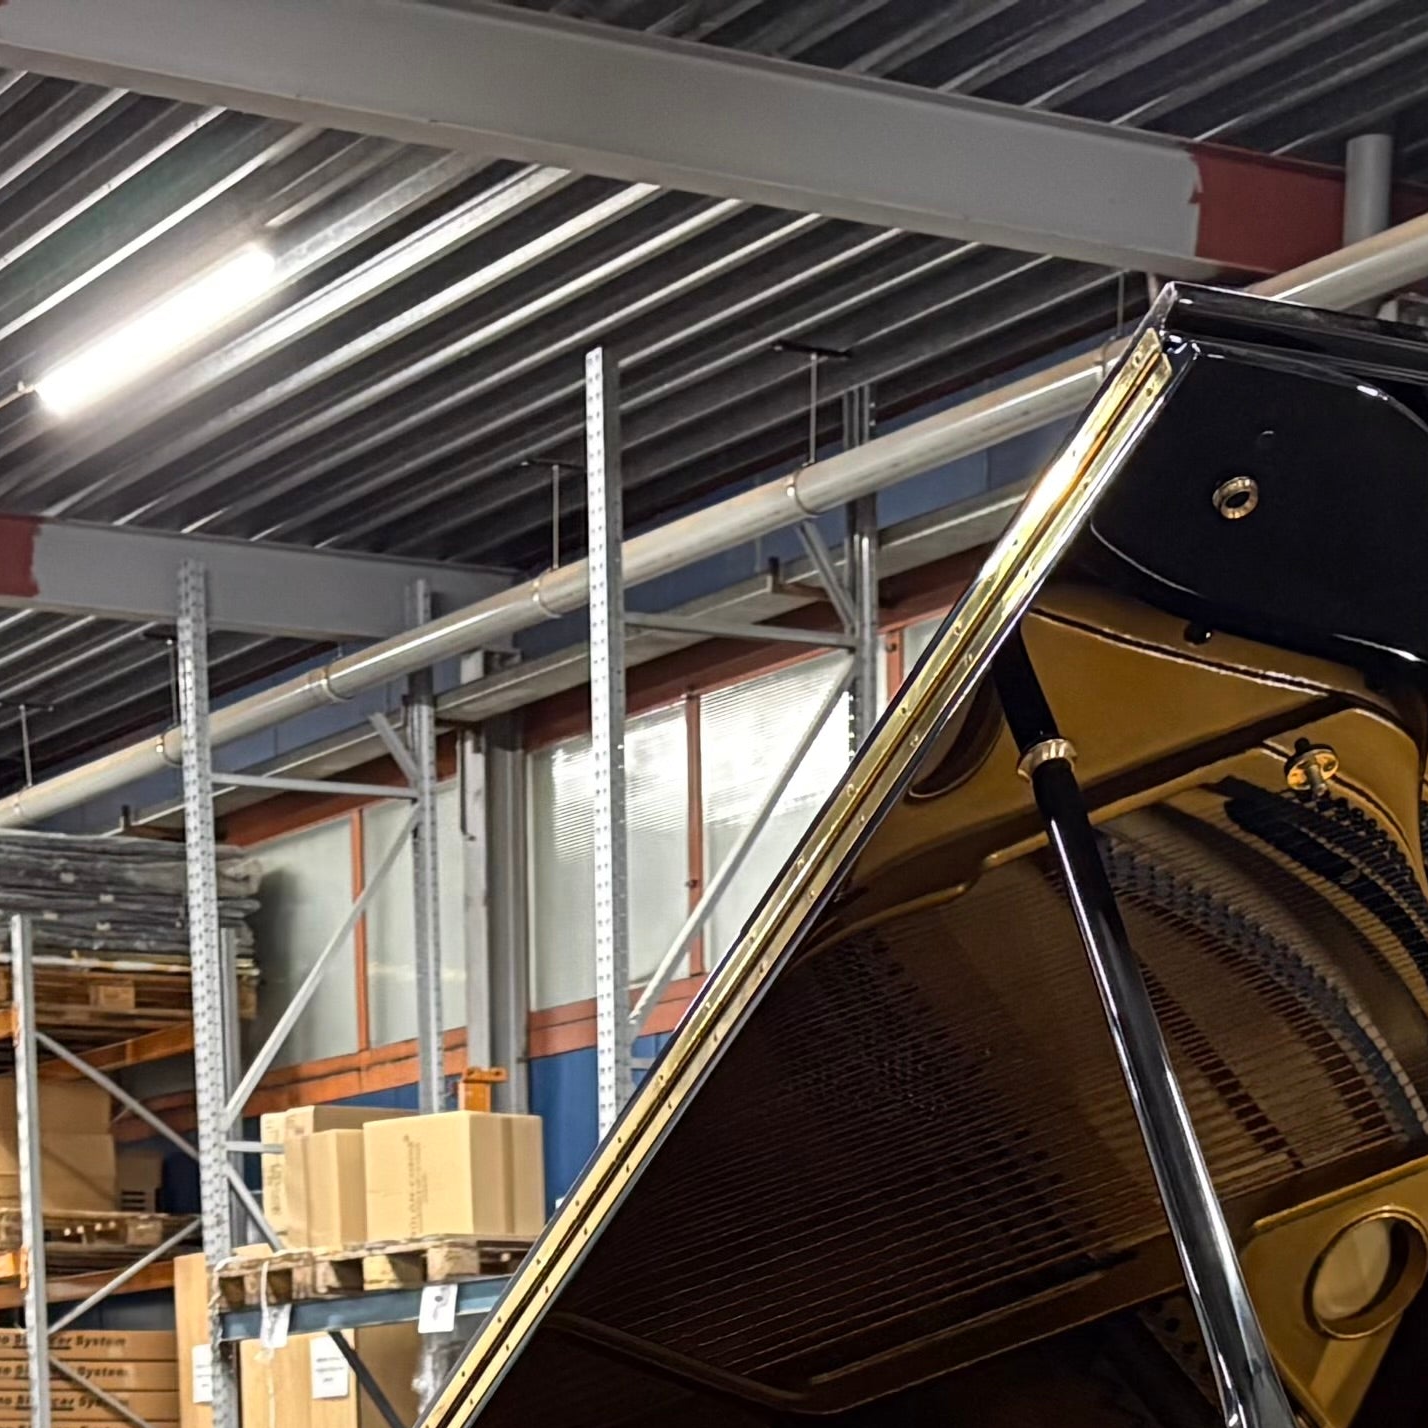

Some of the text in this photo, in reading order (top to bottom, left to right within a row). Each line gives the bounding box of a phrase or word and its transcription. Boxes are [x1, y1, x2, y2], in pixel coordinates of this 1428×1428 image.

[13, 1334, 72, 1345] Sicer
[75, 1335, 127, 1348] System
[77, 1366, 128, 1379] System
[16, 1395, 74, 1406] Sicer
